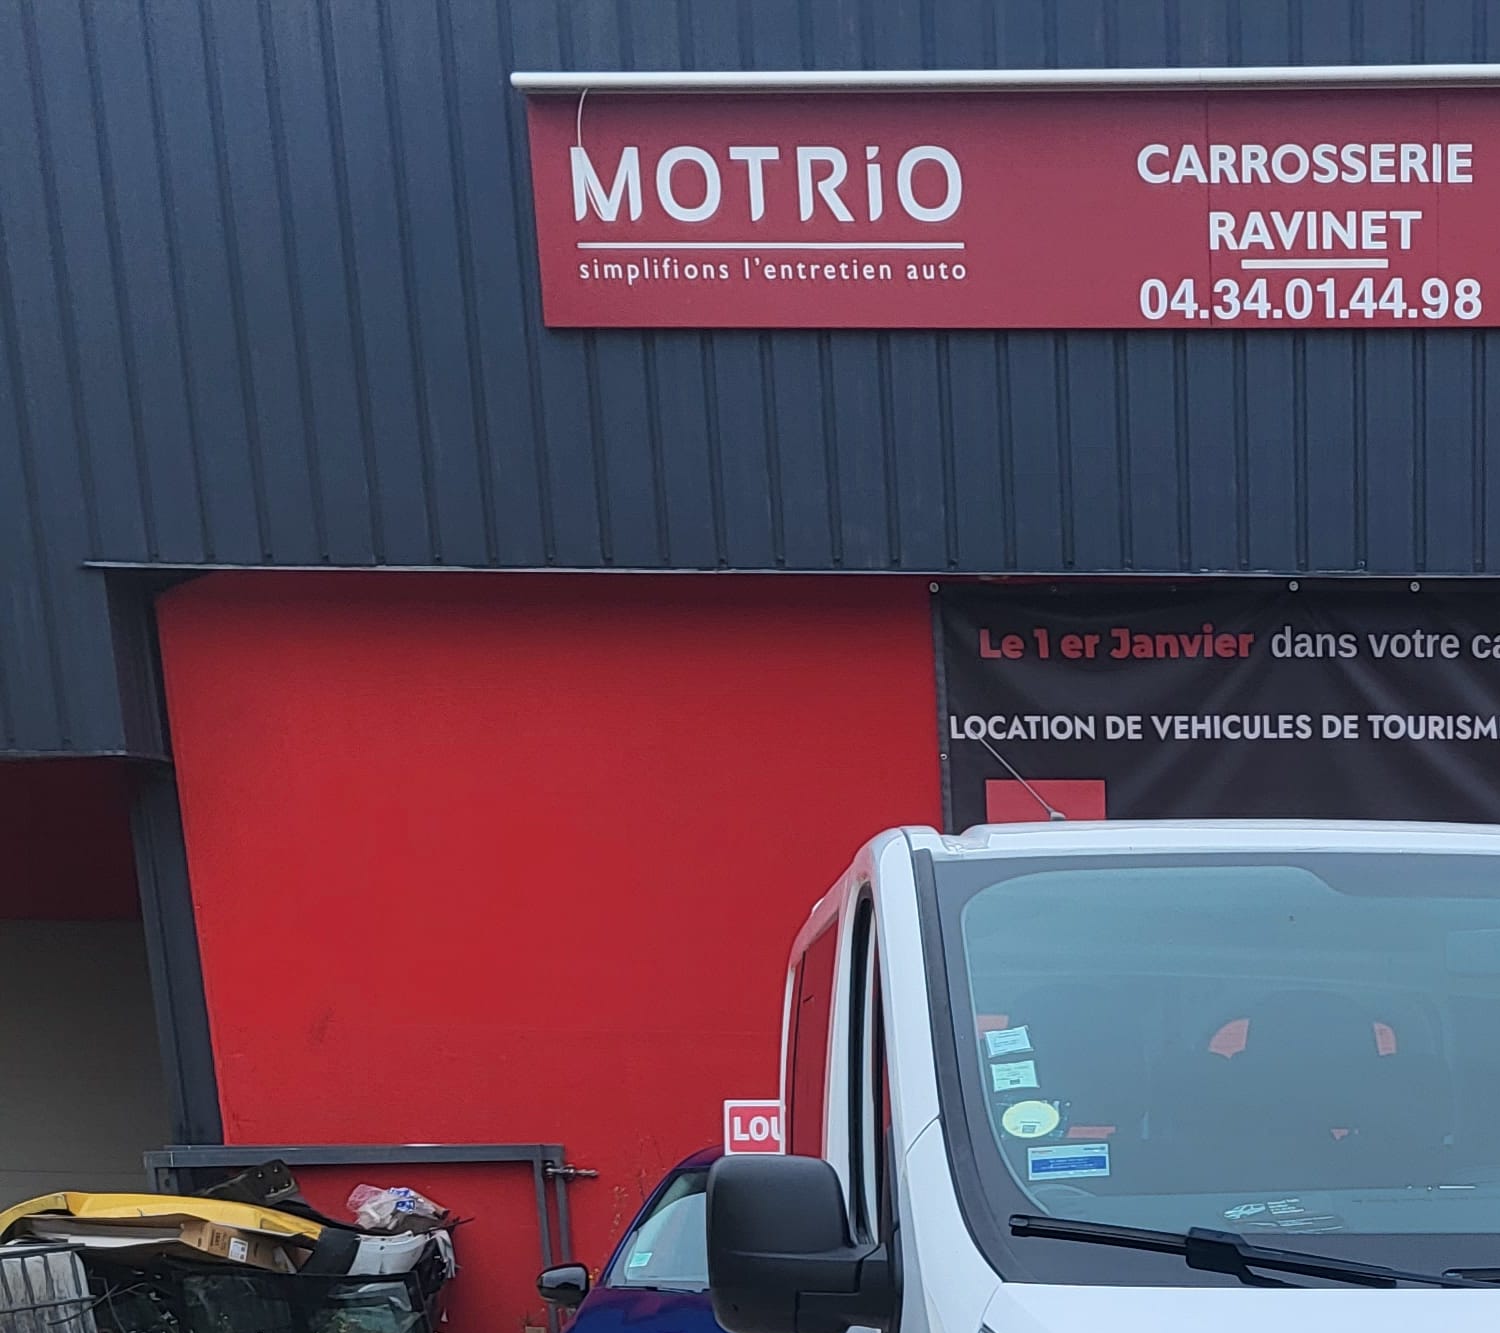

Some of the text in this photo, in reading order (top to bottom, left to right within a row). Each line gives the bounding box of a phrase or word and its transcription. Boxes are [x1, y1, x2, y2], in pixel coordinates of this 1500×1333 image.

[1137, 143, 1473, 184] CARROSSERIE
[1209, 210, 1423, 250] RAVINET
[579, 257, 967, 285] simplifions l'entretien auto
[1139, 277, 1483, 320] 04.34.01.44.98
[979, 628, 1025, 659] Le
[1033, 628, 1049, 659] 1
[1060, 633, 1100, 659] er
[1109, 624, 1255, 659] Janvier
[1271, 625, 1358, 658] dans
[1367, 629, 1460, 659] votre
[950, 714, 1096, 740] LOCATION
[1105, 715, 1143, 740] DE
[1151, 714, 1313, 740] VEHICULES
[1321, 715, 1359, 740] DE
